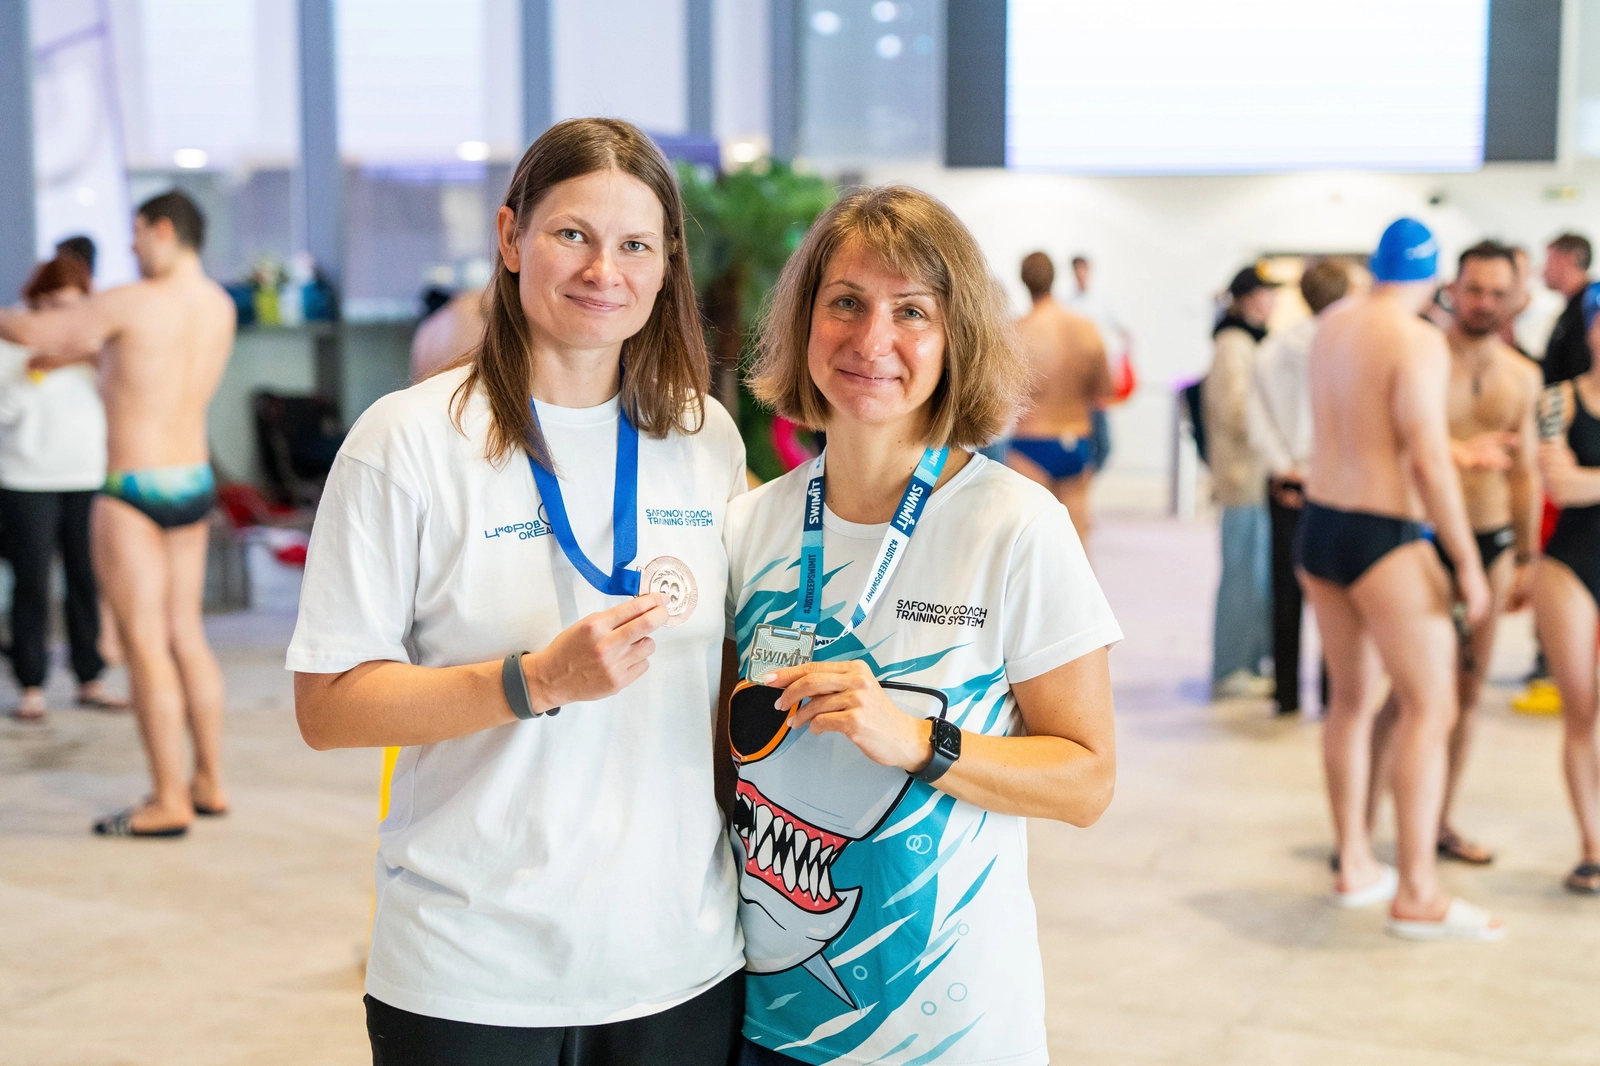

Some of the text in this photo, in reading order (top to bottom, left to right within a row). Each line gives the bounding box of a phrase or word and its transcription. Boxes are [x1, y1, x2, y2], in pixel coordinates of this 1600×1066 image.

[645, 508, 713, 518] SAFONOV COACH
[808, 480, 821, 525] SWIMIT
[896, 484, 924, 531] SWIMIT
[647, 516, 714, 527] TRAINING SYSTEM
[518, 526, 554, 540] ОКЕА
[865, 539, 899, 604] #JUSTKEEPSWIMIT
[803, 553, 817, 615] #JUSTKEEPSWIMIT
[895, 608, 985, 629] TRAINING SYSTEM
[896, 599, 988, 619] SAFONOV COACH
